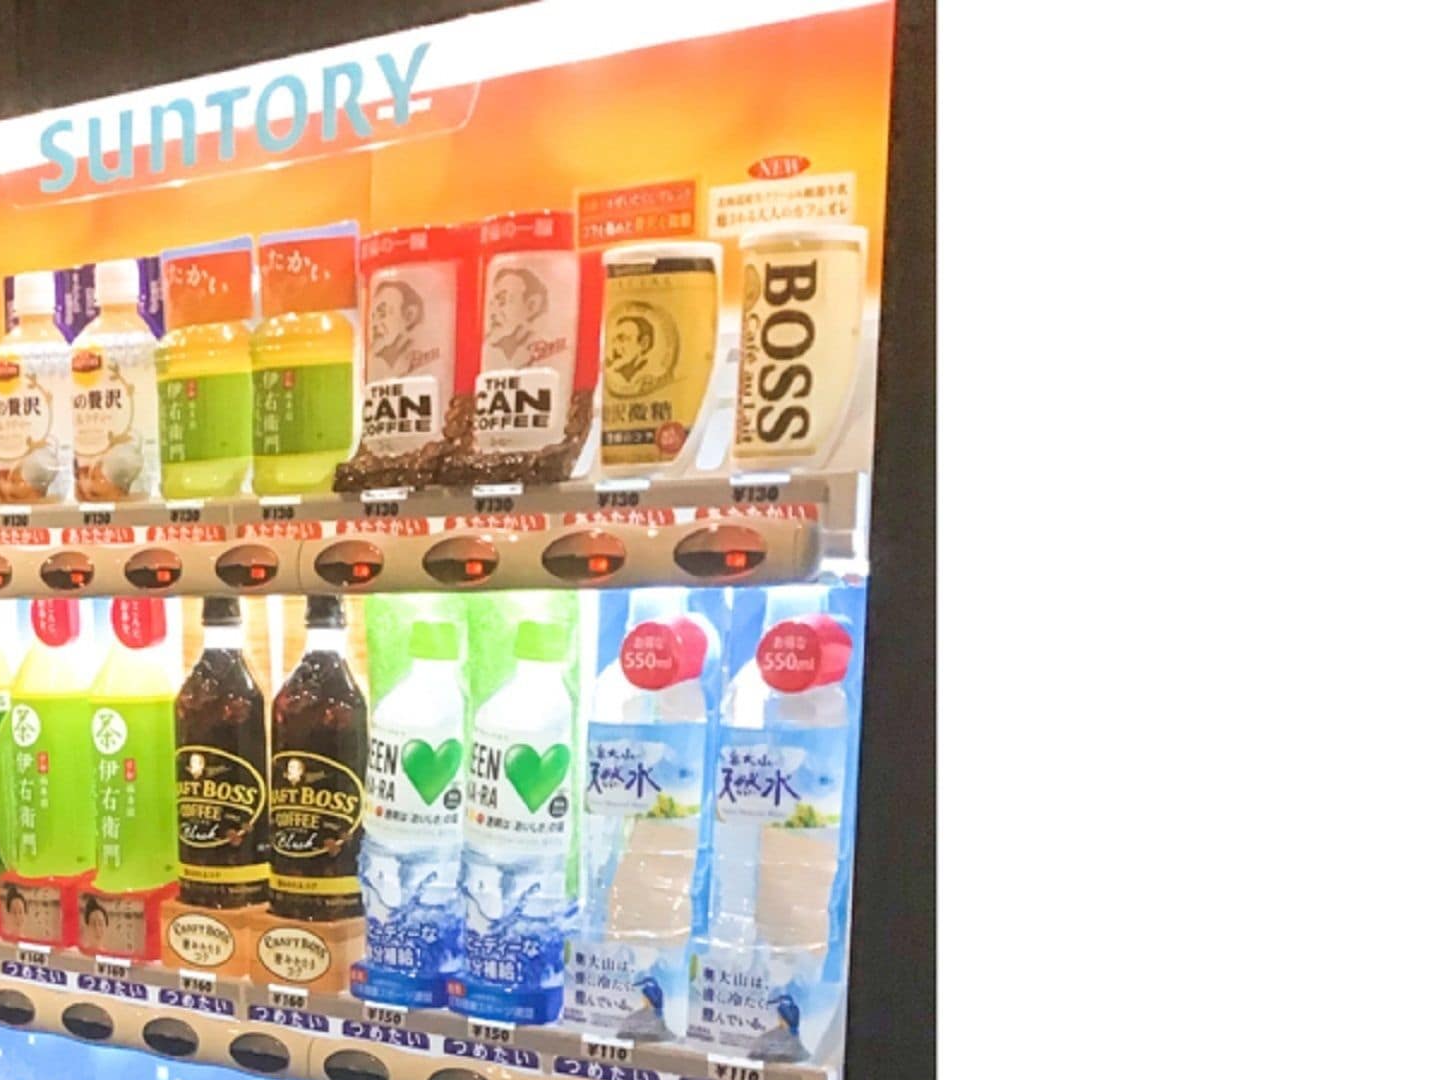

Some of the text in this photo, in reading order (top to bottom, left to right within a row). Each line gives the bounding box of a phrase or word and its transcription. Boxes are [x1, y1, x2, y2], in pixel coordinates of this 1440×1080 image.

[39, 42, 431, 193] SUNTORY
[756, 260, 817, 444] BOSS
[372, 384, 403, 397] THE
[486, 376, 521, 390] THE
[364, 394, 432, 422] CAN
[477, 388, 552, 415] CAN
[363, 418, 432, 438] COFFEE
[474, 414, 549, 431] COFFEE
[625, 651, 673, 669] 550ml
[763, 652, 815, 672] 550ml
[16, 752, 37, 857] 伊右衛門
[203, 779, 258, 806] BOSS
[301, 786, 359, 815] BOSS
[99, 758, 122, 869] 伊右衛門
[6, 962, 64, 983] つめたい
[82, 976, 143, 998] つめたい
[164, 990, 229, 1015] つめたい
[252, 1006, 325, 1030] つめたい
[366, 1009, 403, 1025] ¥150
[348, 1022, 424, 1048] つめたい
[472, 1024, 511, 1042] ¥150
[451, 1040, 532, 1066] つめたい
[587, 1043, 628, 1062] ¥110
